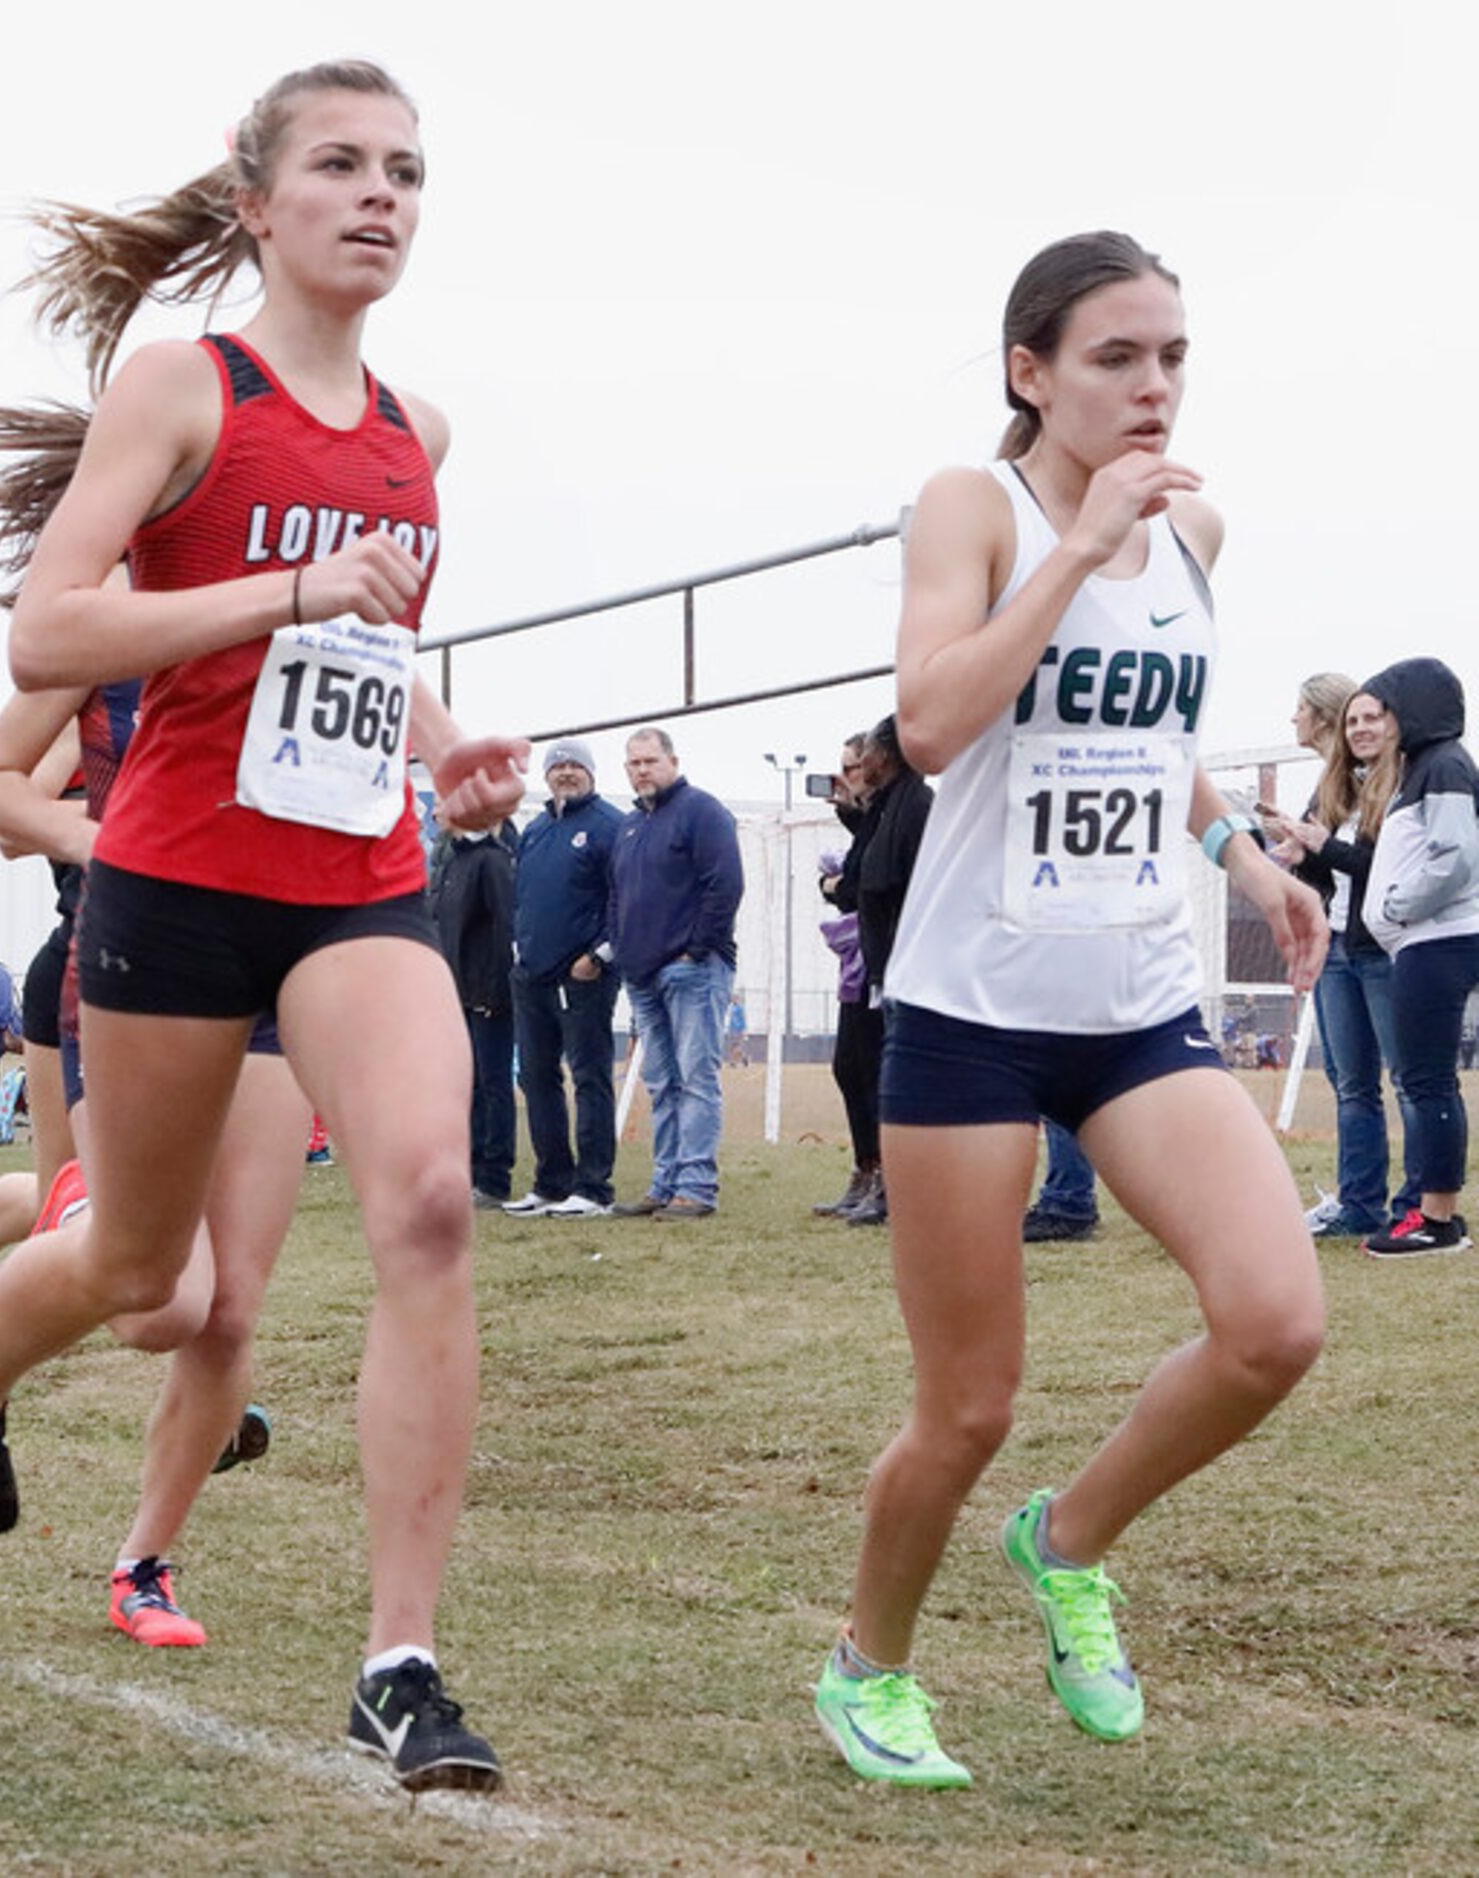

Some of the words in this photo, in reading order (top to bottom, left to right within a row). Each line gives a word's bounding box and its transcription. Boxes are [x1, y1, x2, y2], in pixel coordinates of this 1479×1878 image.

[245, 504, 438, 572] LOVEOY
[278, 660, 405, 756] 1569
[1032, 763, 1052, 776] XC
[1086, 747, 1134, 761] Region
[1025, 788, 1162, 857] 1521
